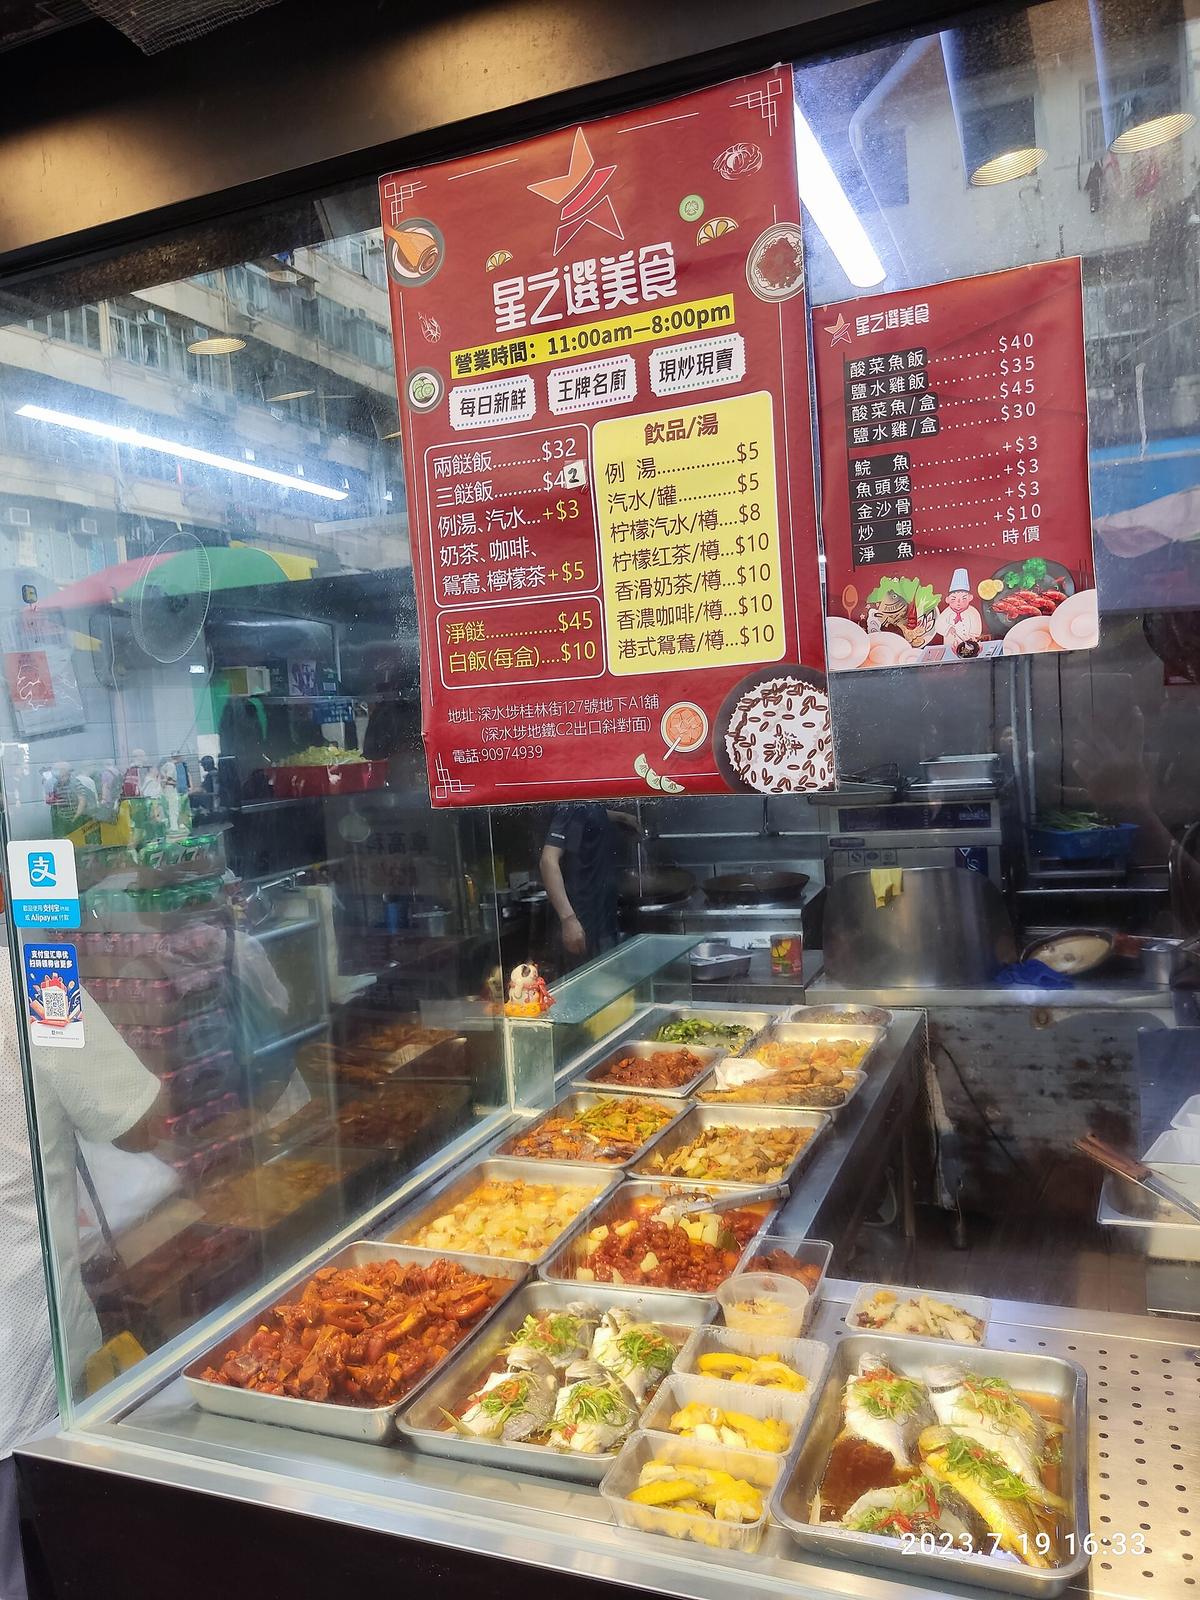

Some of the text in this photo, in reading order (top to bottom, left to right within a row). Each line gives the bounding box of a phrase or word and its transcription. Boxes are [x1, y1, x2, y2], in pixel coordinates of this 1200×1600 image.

[493, 242, 679, 333] 星之選美食
[855, 303, 930, 337] 星之選美食
[998, 332, 1034, 354] $40
[658, 347, 735, 383] 現炒現賣
[999, 355, 1035, 376] $35
[558, 368, 627, 404] 王牌名廚
[999, 379, 1035, 399] $45
[460, 386, 527, 418] 每日新鮮
[1000, 402, 1036, 422] $30
[644, 412, 719, 446] 飲品/湯
[541, 438, 577, 462] $32
[736, 441, 759, 464] $5
[1002, 435, 1039, 455] +$3
[1003, 458, 1039, 477] +$3
[737, 472, 760, 494] $5
[1004, 481, 1040, 500] +$3
[542, 499, 580, 522] +$3
[738, 502, 761, 525] $8
[993, 503, 1042, 523] +$10
[735, 532, 770, 556] $10
[1002, 525, 1040, 545] 時價
[737, 563, 771, 586] $10
[738, 593, 773, 616] $10
[558, 610, 593, 633] $45
[740, 624, 775, 647] $10
[560, 641, 596, 663] $10
